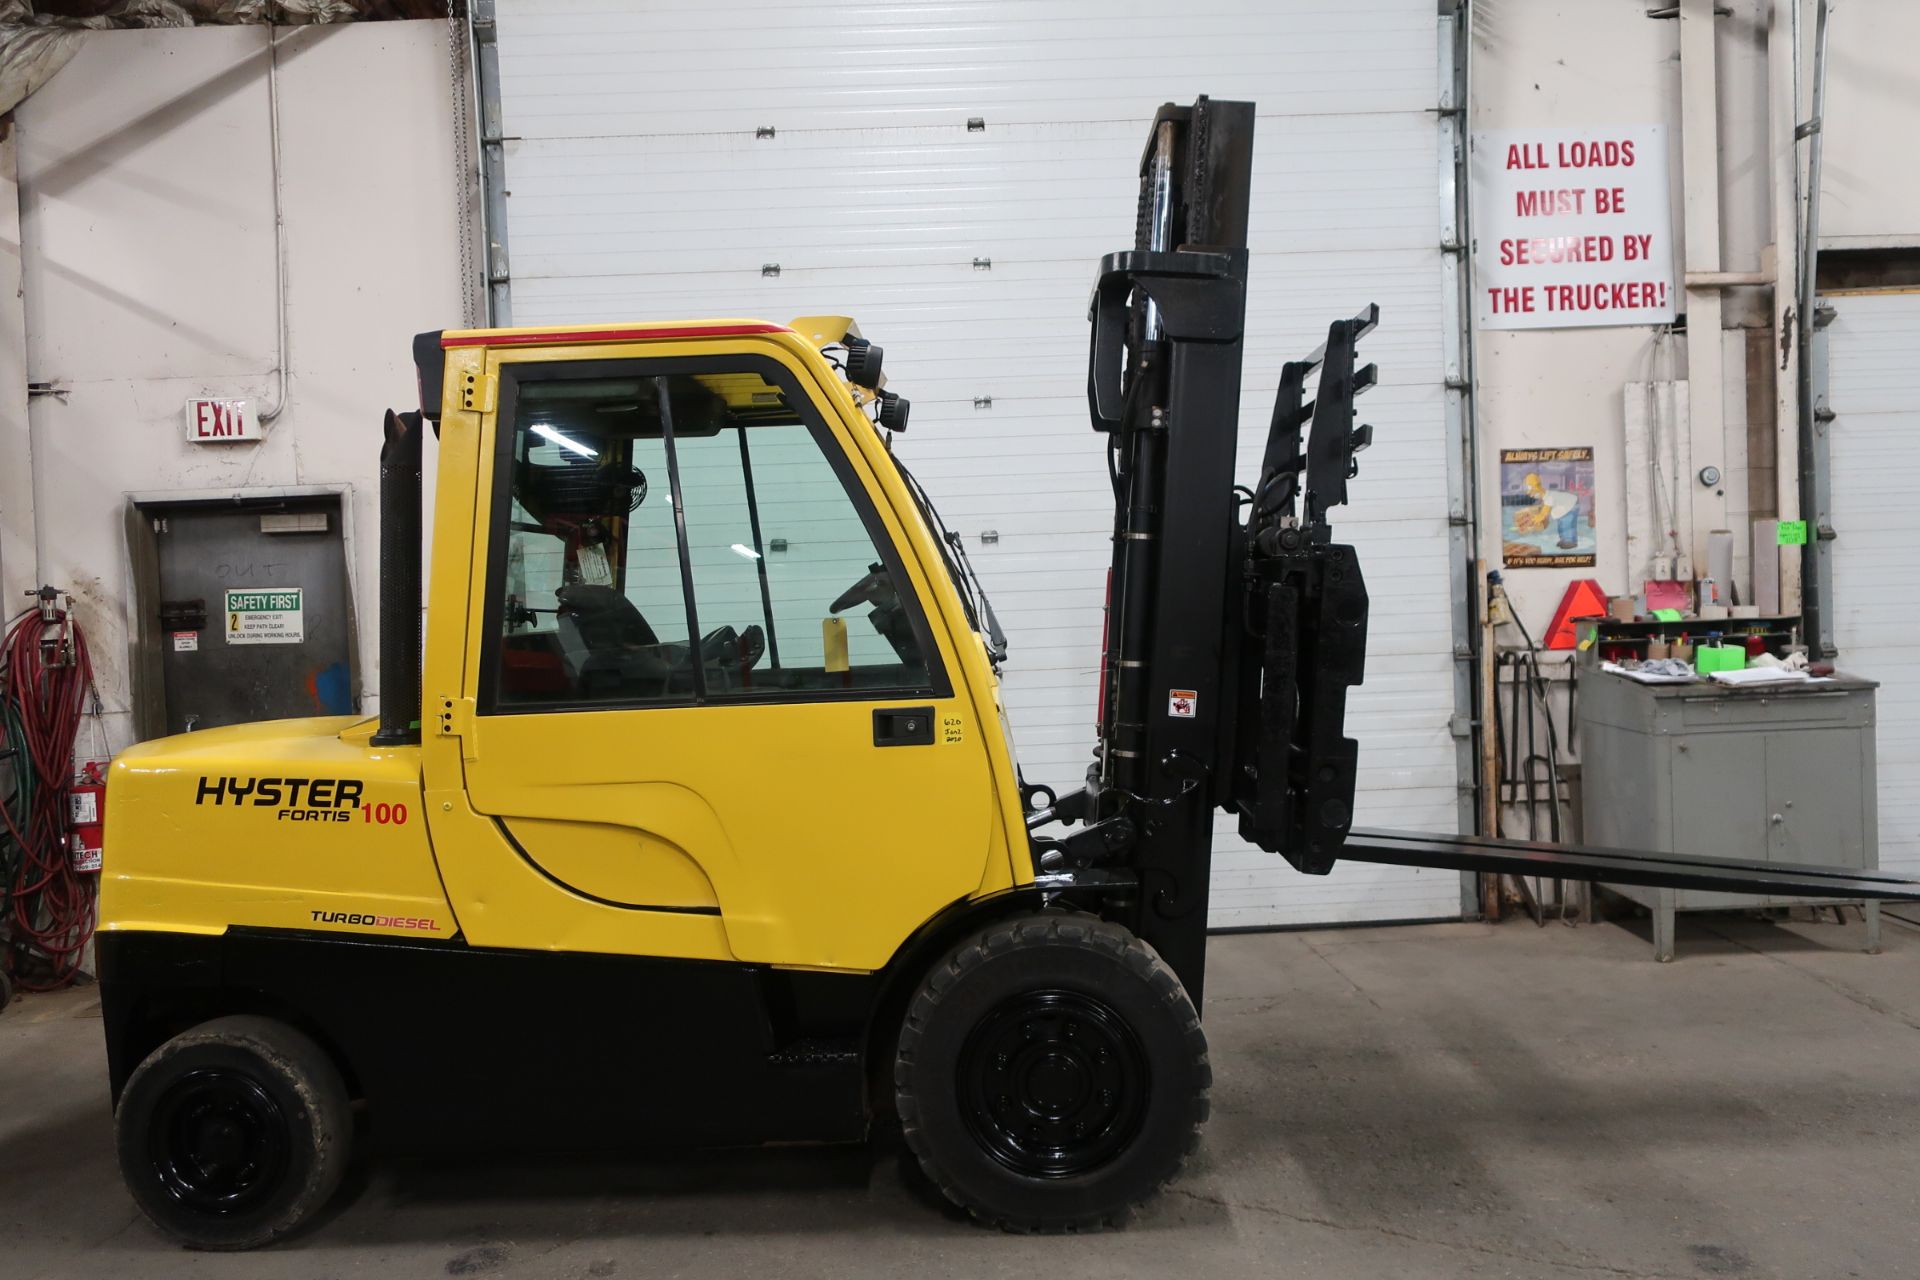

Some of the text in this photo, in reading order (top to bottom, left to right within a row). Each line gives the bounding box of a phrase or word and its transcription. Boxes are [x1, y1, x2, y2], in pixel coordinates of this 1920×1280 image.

[1506, 139, 1635, 170] ALL LOADS
[1516, 187, 1625, 217] MUST BE
[1500, 233, 1653, 266] SECURED BY
[1487, 281, 1667, 314] THE TRUCKER!
[196, 401, 246, 437] EXIT
[230, 594, 298, 610] SAFETY FIRST
[231, 613, 238, 631] 2
[195, 776, 364, 809] HYSTER
[277, 809, 351, 823] FORTIS
[361, 802, 408, 825] 100
[310, 910, 441, 931] TURBODIESEL
